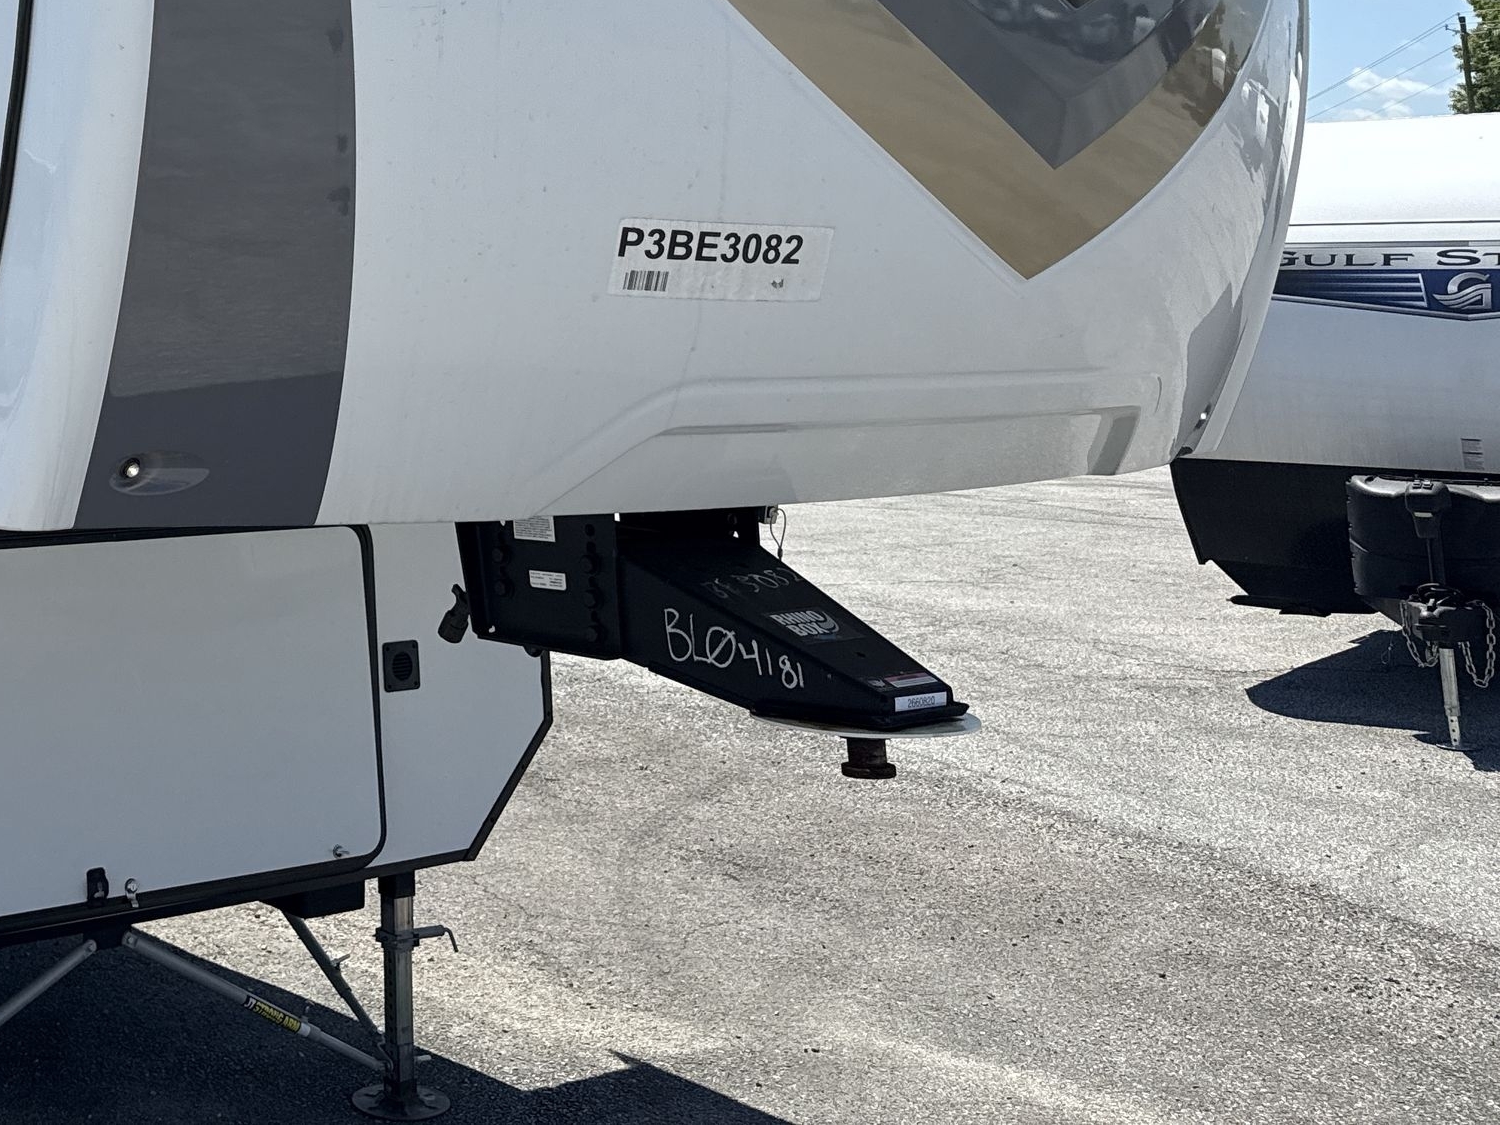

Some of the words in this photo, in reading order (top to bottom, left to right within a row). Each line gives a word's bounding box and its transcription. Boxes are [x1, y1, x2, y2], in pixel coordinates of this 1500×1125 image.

[617, 226, 804, 264] P3BE3082
[770, 610, 826, 626] RHINO
[785, 622, 830, 637] BOX
